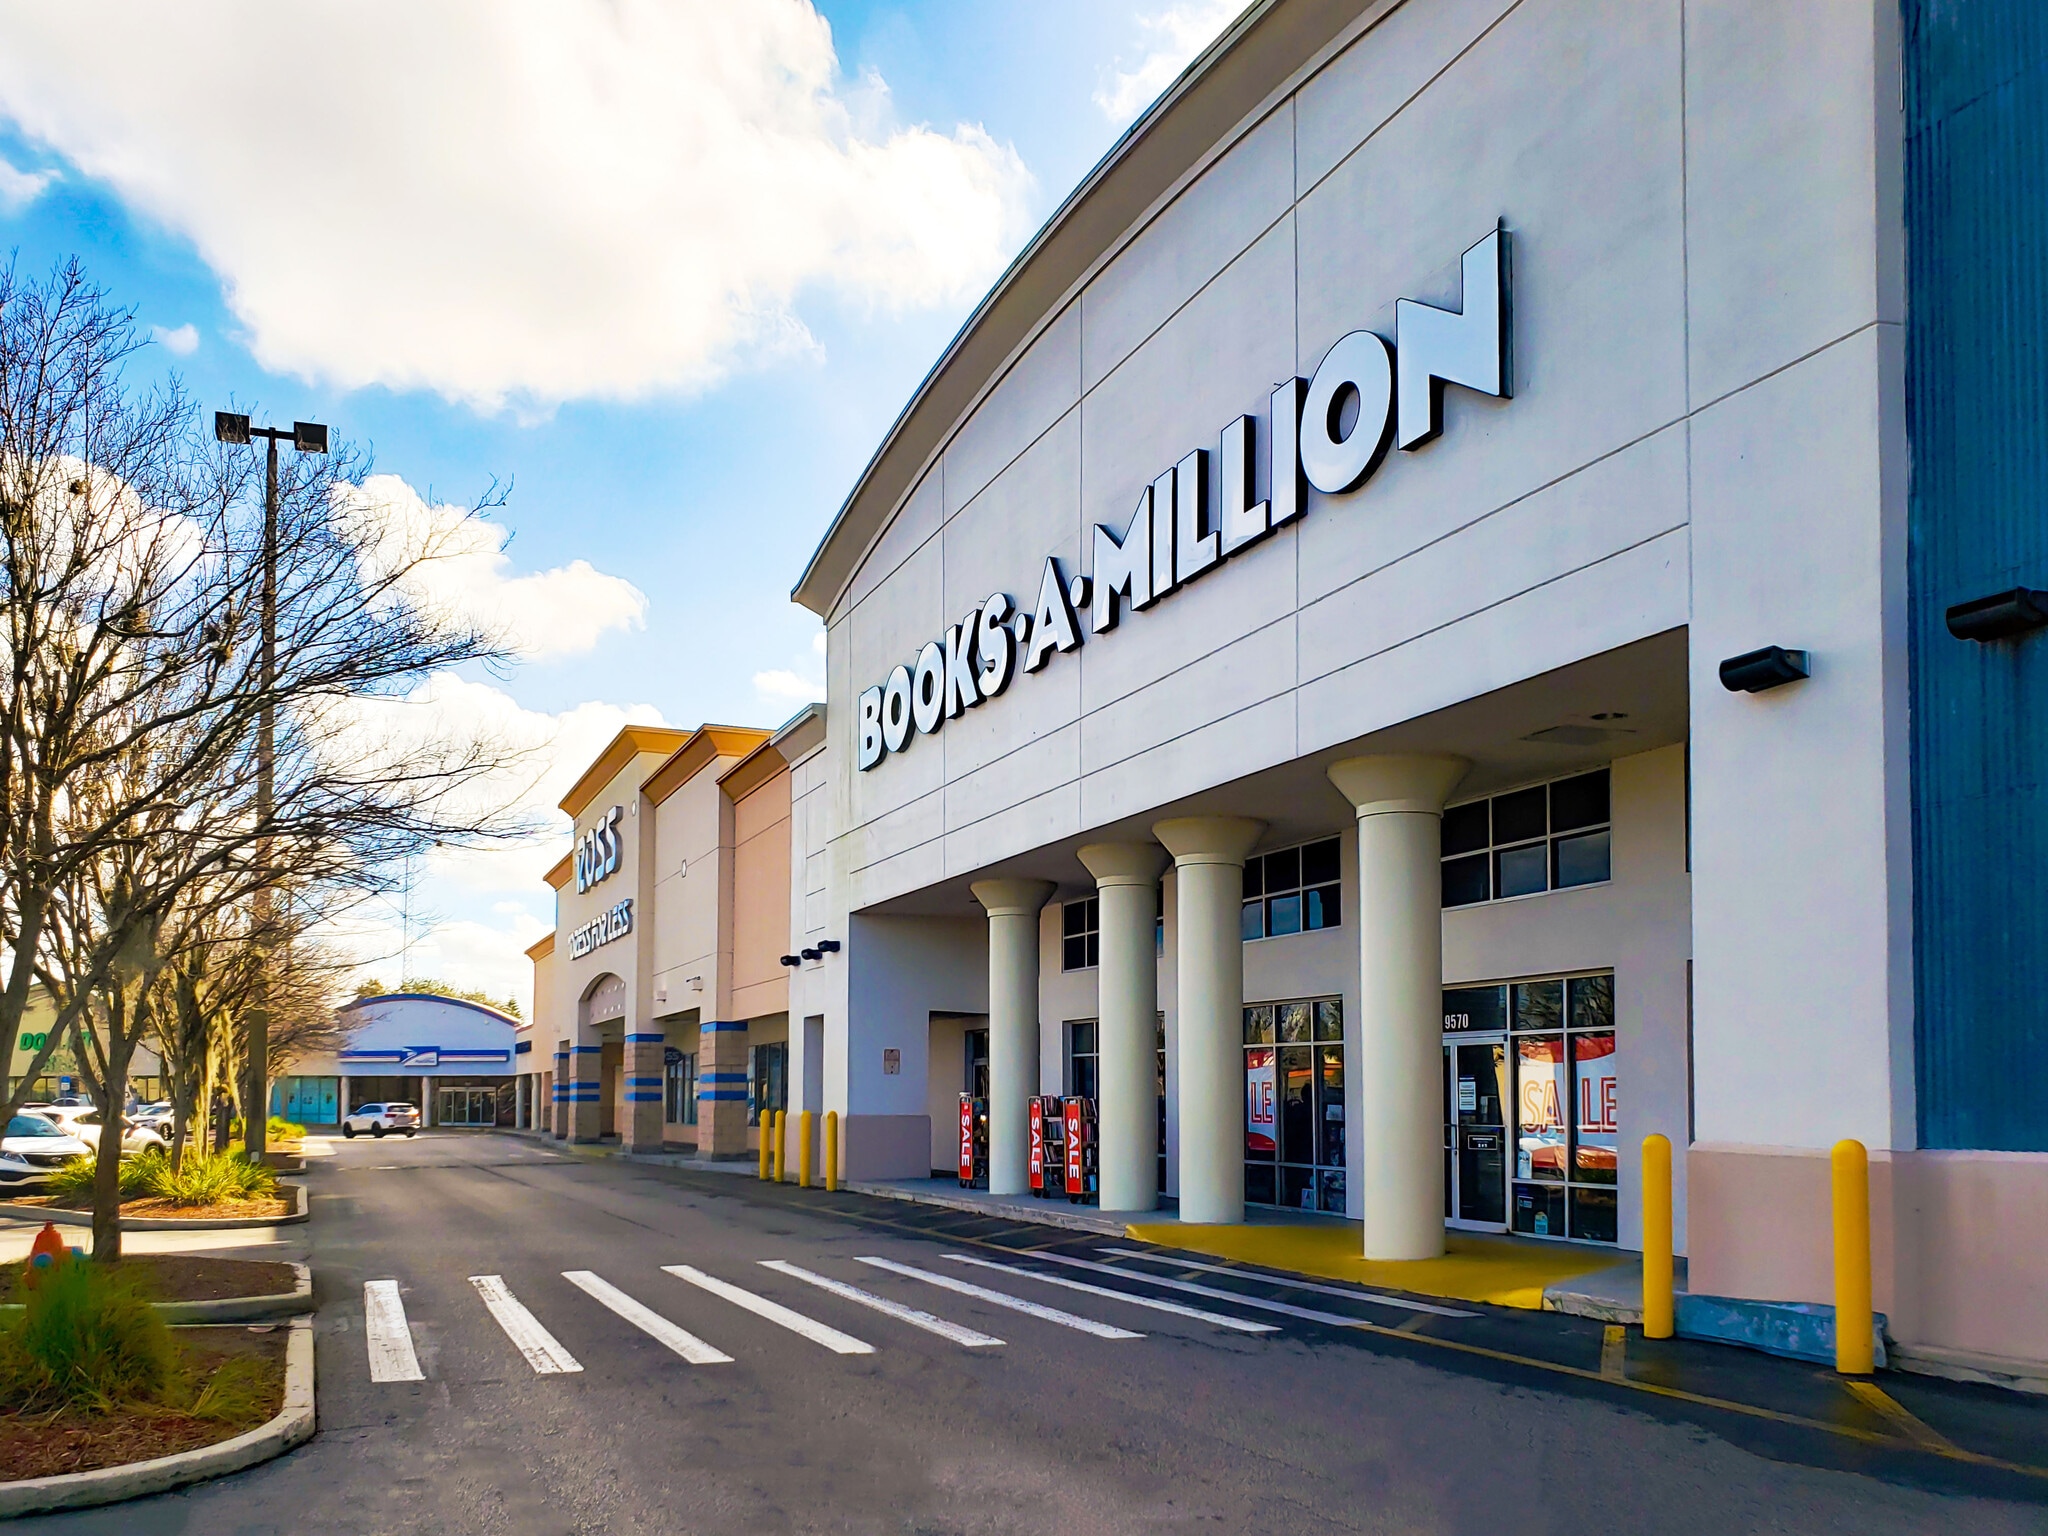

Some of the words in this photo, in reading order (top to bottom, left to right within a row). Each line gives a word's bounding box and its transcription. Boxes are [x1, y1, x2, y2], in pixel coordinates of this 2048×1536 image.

[576, 805, 624, 895] ROSS
[607, 898, 634, 943] LESS
[1444, 1013, 1469, 1029] 9570
[1250, 1081, 1274, 1124] LE
[1523, 1076, 1617, 1134] SALE
[961, 1114, 971, 1168] SALE
[1031, 1116, 1041, 1175] SALE
[1067, 1118, 1080, 1179] SALE
